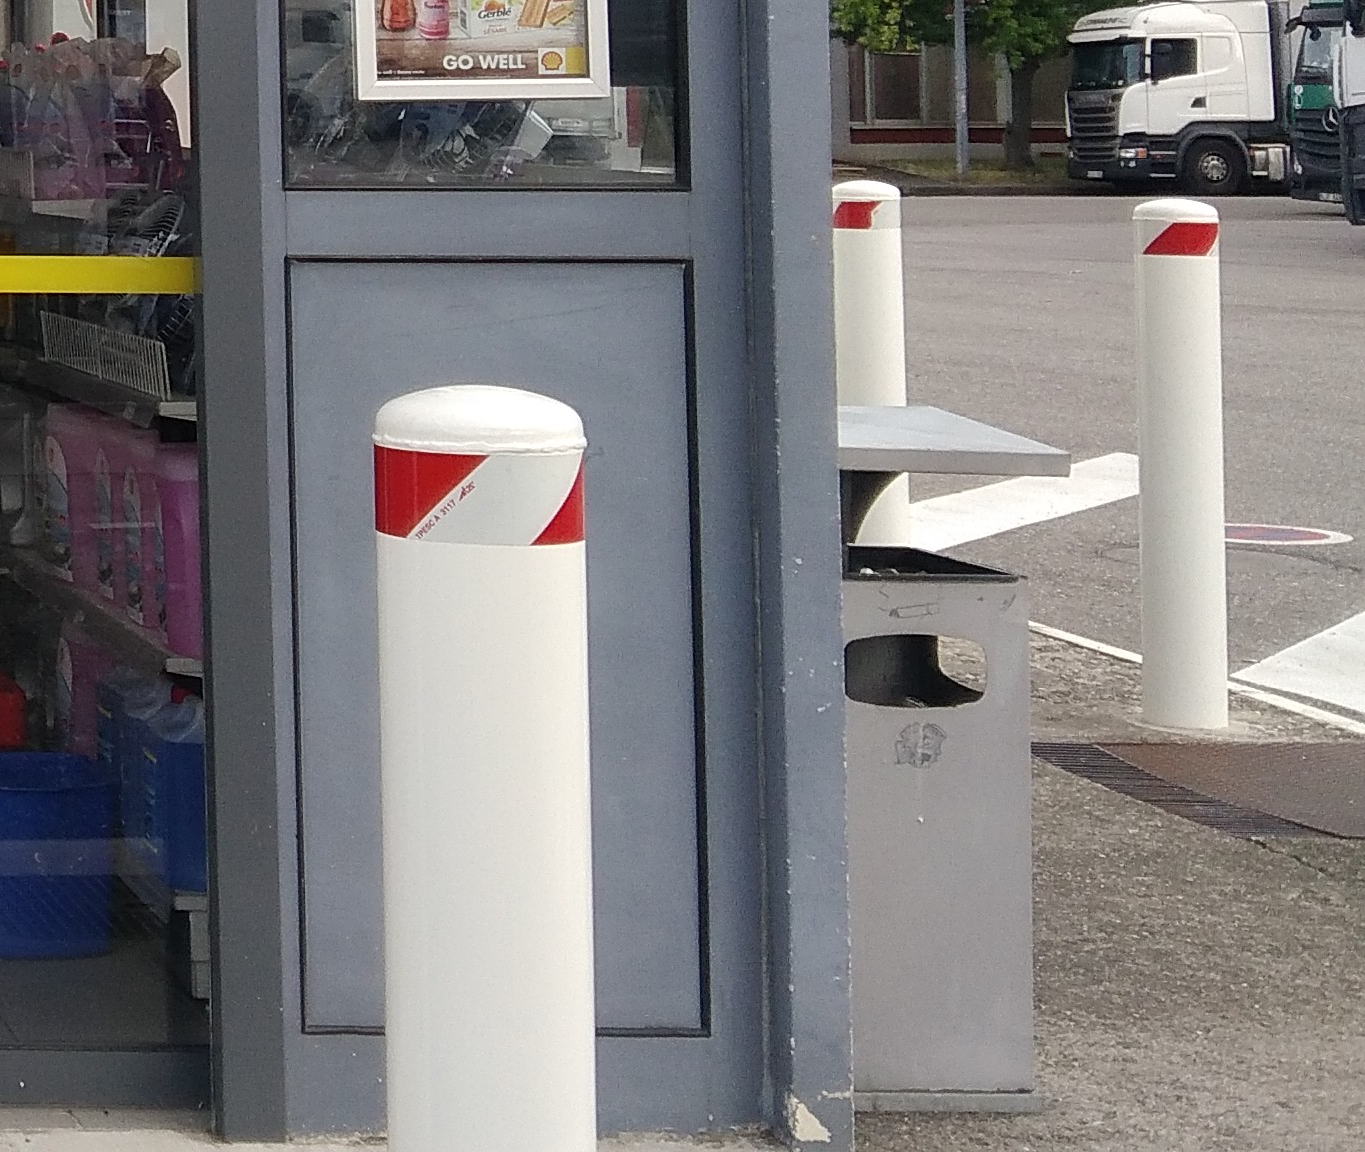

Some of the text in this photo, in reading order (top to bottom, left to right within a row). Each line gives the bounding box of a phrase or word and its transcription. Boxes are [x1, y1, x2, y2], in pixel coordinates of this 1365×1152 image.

[477, 7, 512, 20] Gerblé
[442, 54, 526, 70] GO WELL
